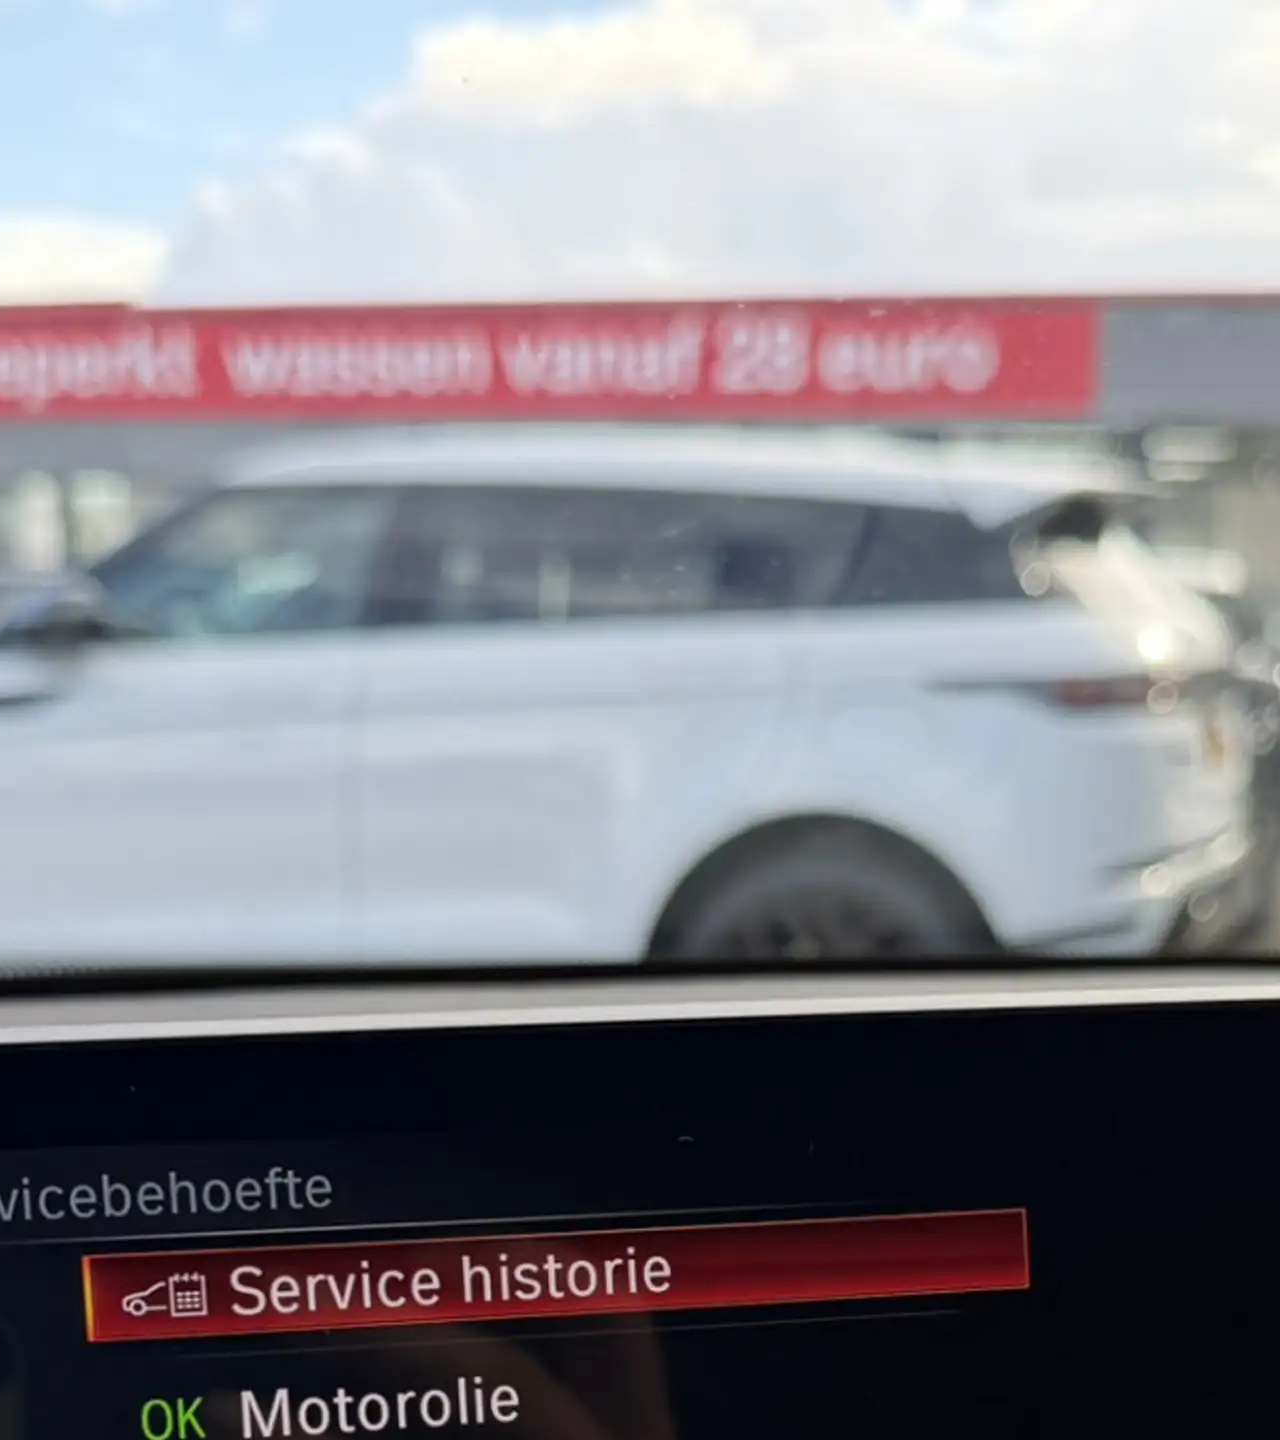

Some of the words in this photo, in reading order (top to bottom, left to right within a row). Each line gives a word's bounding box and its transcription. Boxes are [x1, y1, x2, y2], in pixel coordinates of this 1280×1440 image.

[224, 336, 494, 397] wassen
[504, 324, 700, 395] vanaf
[822, 330, 997, 393] euro
[231, 1261, 440, 1315] Service
[462, 1247, 671, 1302] historie
[141, 1397, 206, 1440] OK
[241, 1376, 519, 1439] Motorolie
